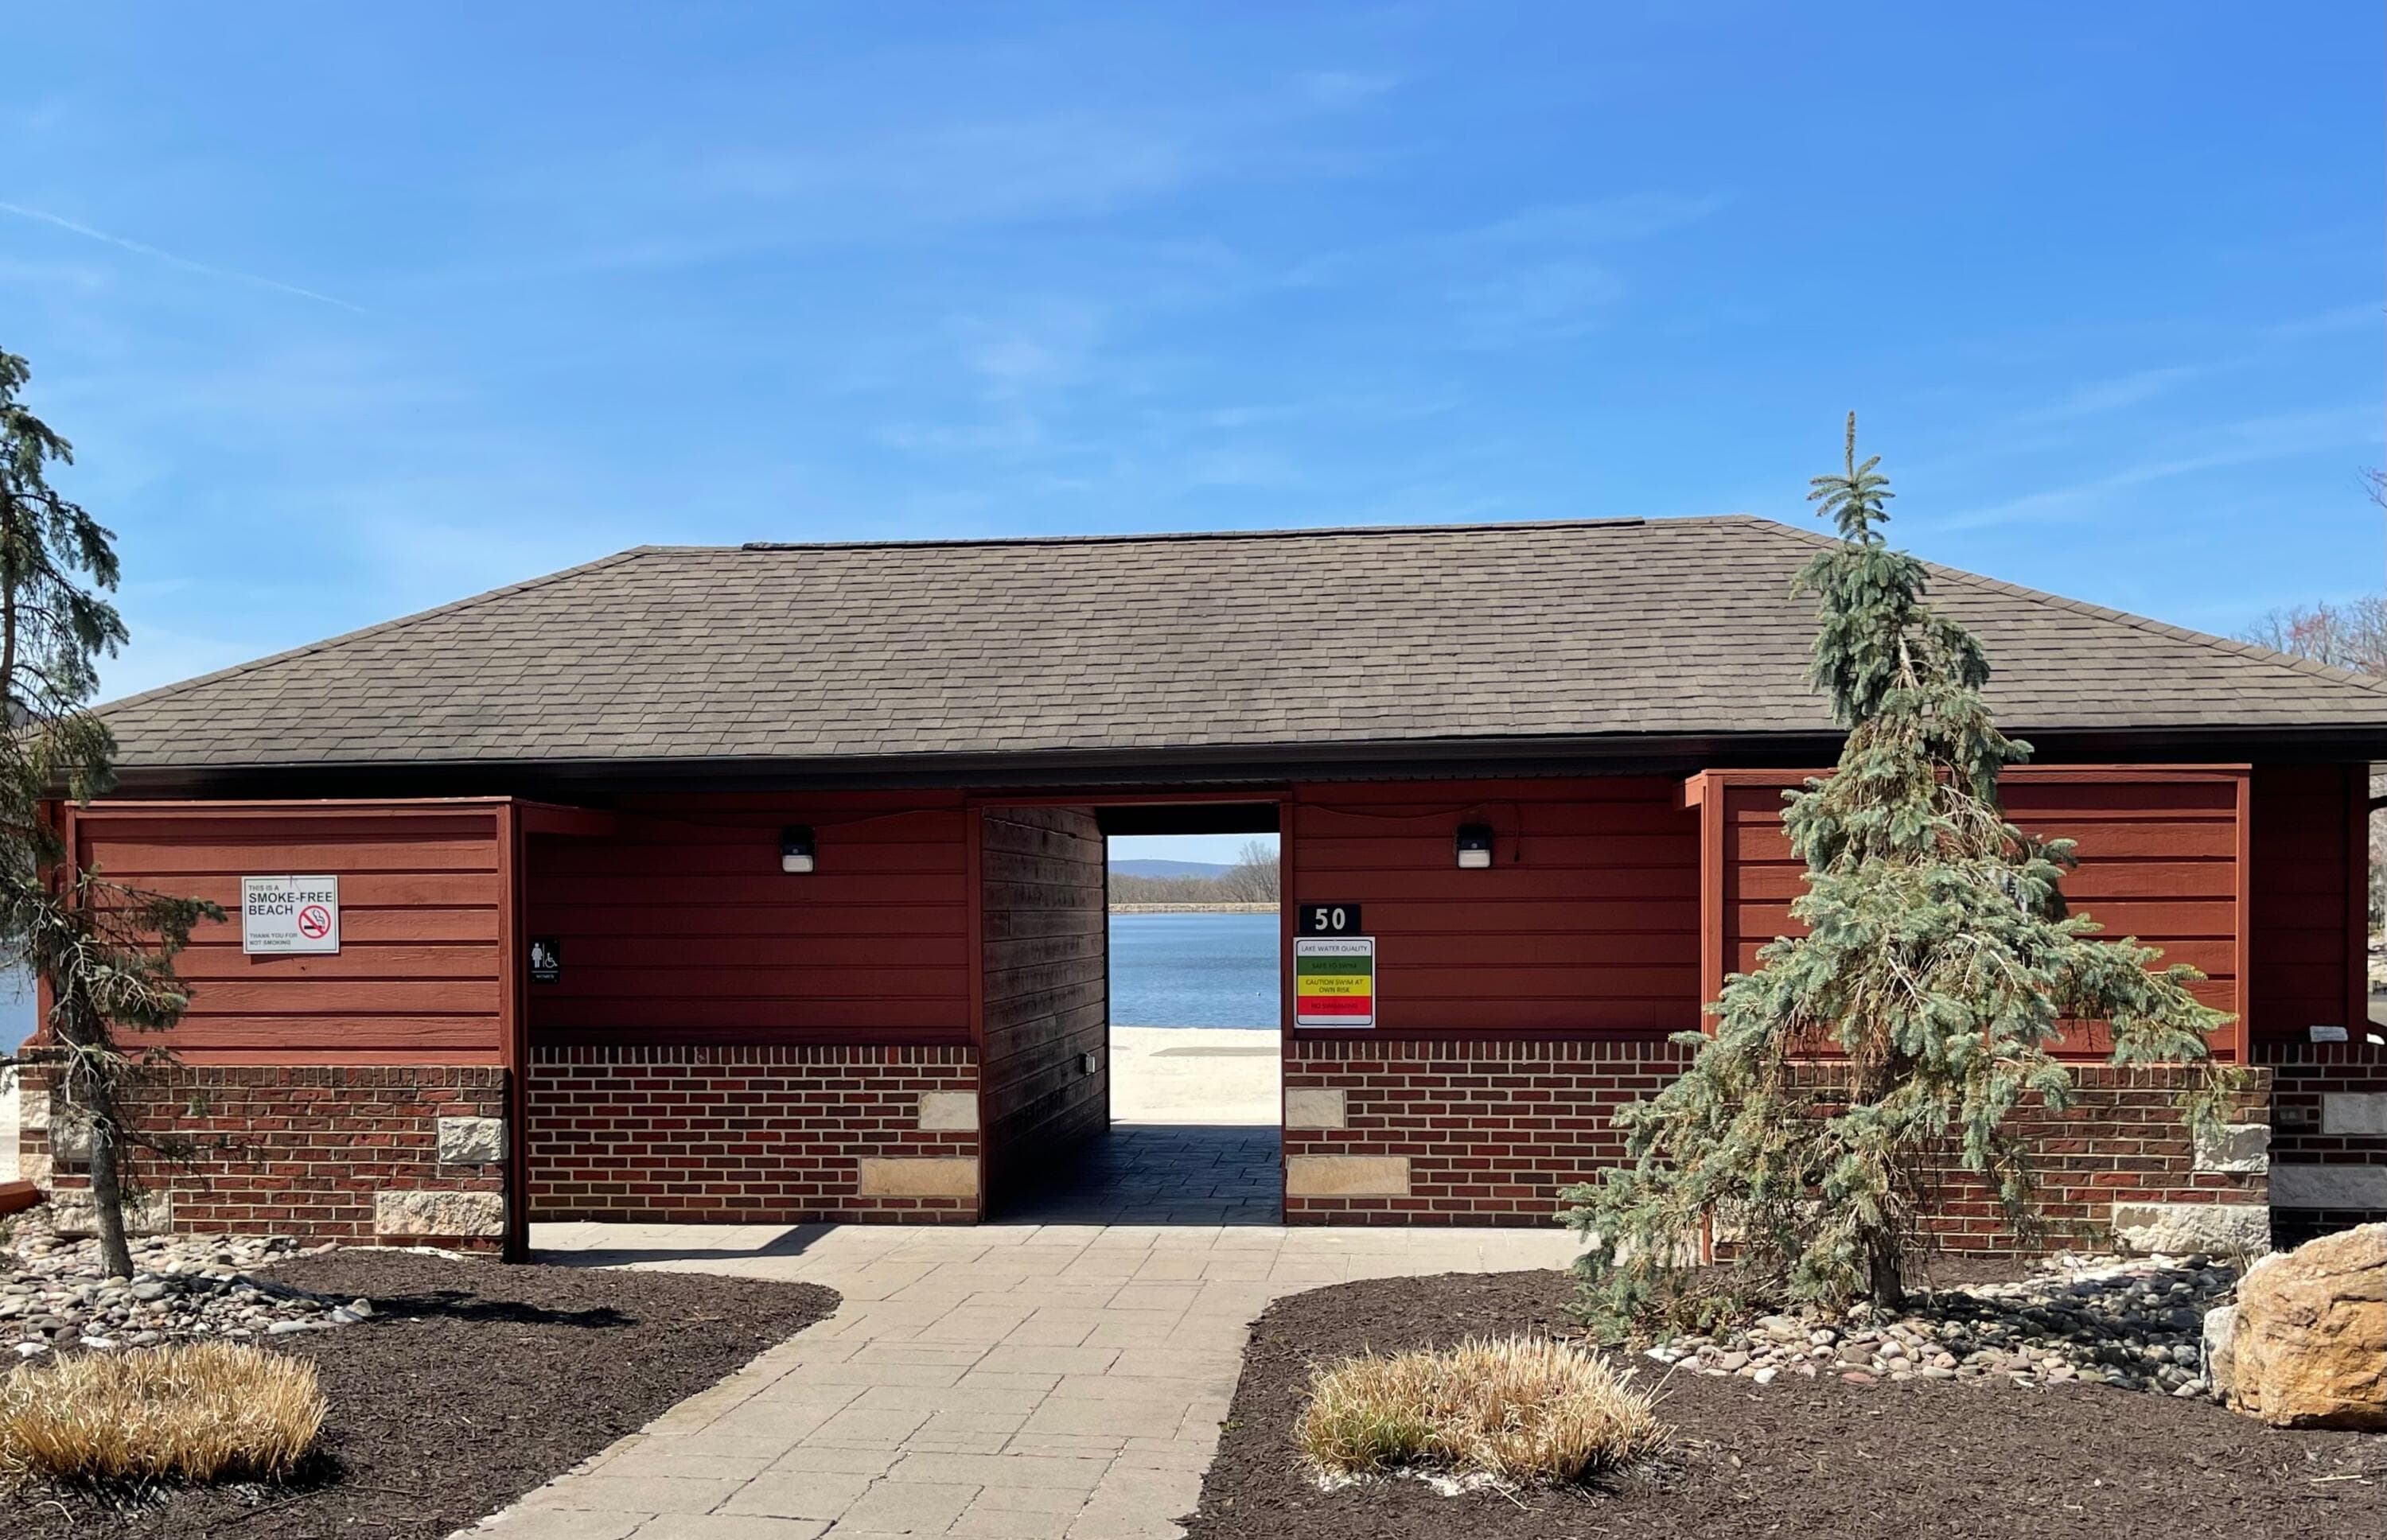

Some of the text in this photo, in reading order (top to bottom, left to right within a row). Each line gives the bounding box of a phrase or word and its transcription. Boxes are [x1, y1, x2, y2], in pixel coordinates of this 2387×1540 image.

[249, 892, 333, 903] SMOKE-FREE
[249, 905, 293, 916] BEACH
[1315, 908, 1345, 930] 50
